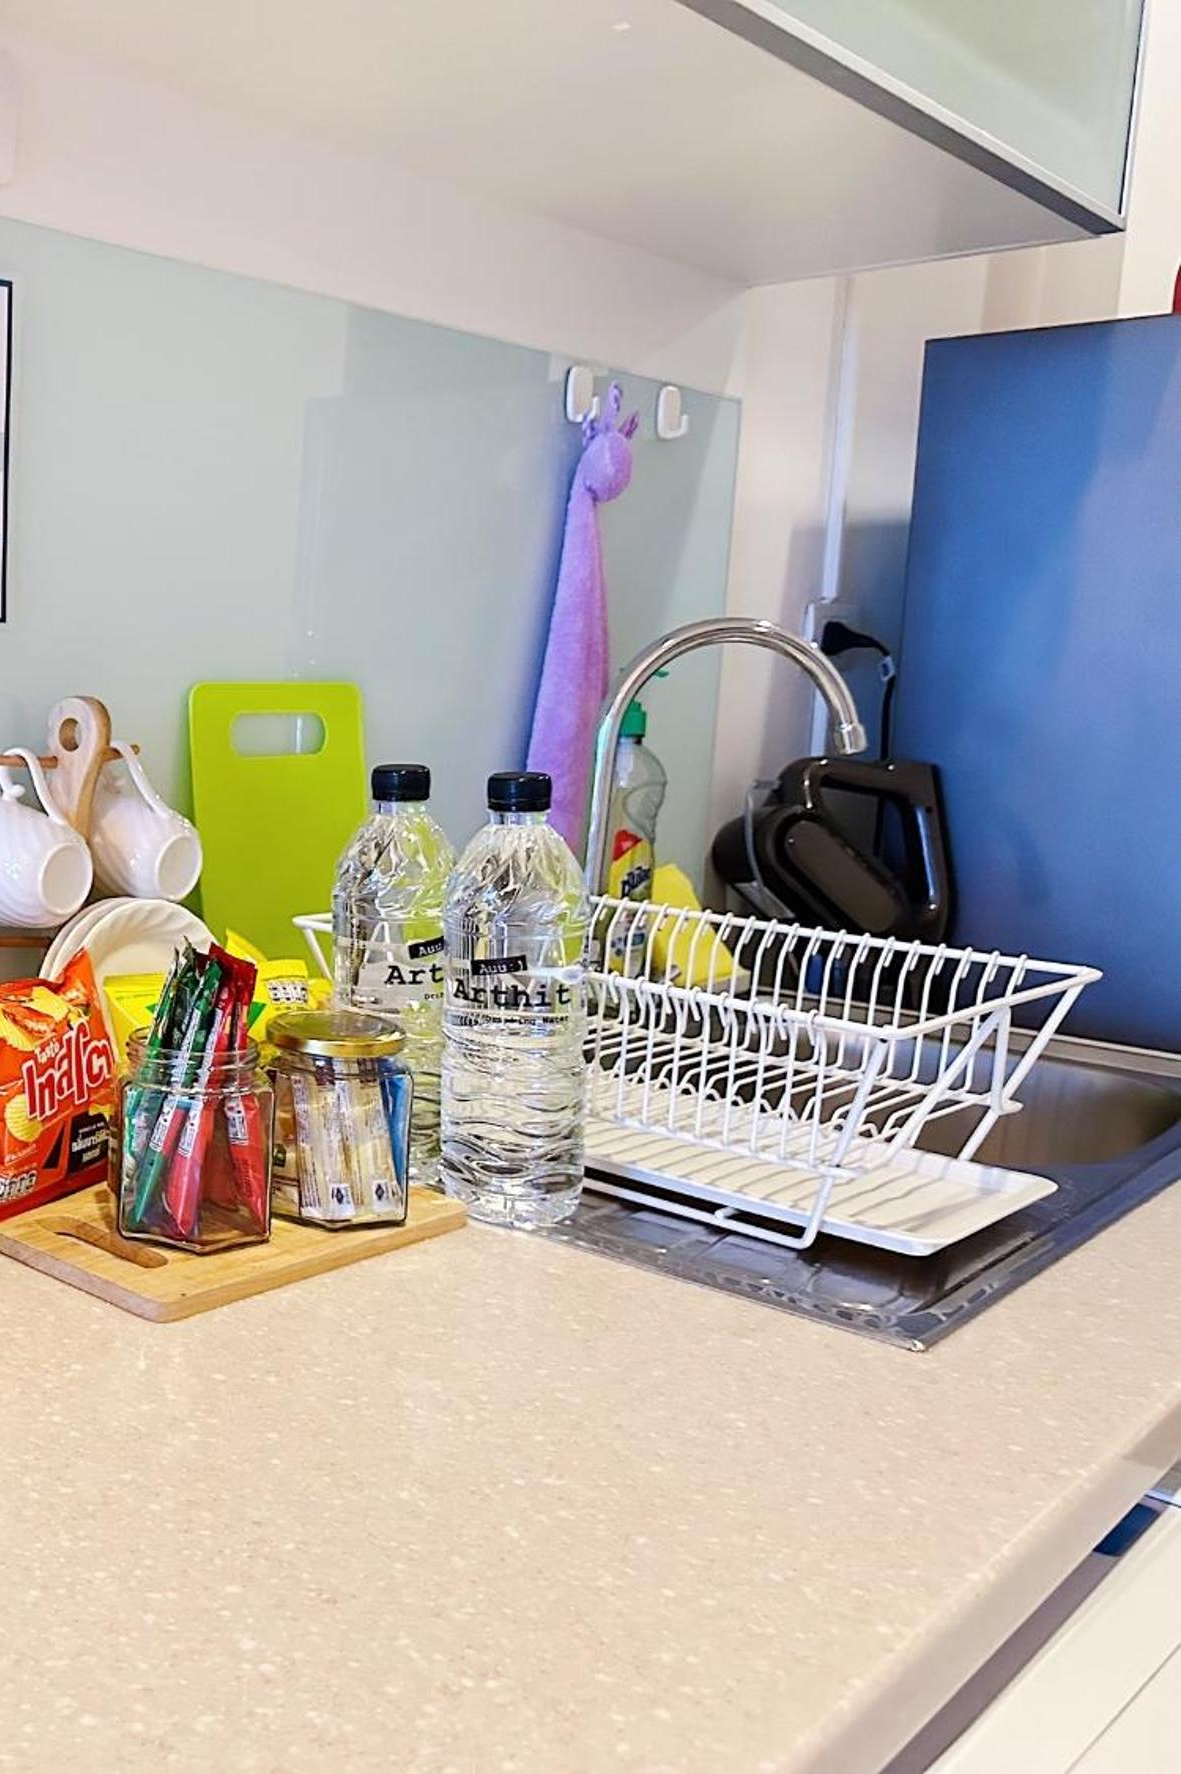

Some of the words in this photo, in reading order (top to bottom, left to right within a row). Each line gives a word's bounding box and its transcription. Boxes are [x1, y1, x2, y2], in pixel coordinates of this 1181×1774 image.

[385, 964, 444, 986] Art
[453, 978, 571, 1007] Arthit
[543, 1015, 569, 1024] Water
